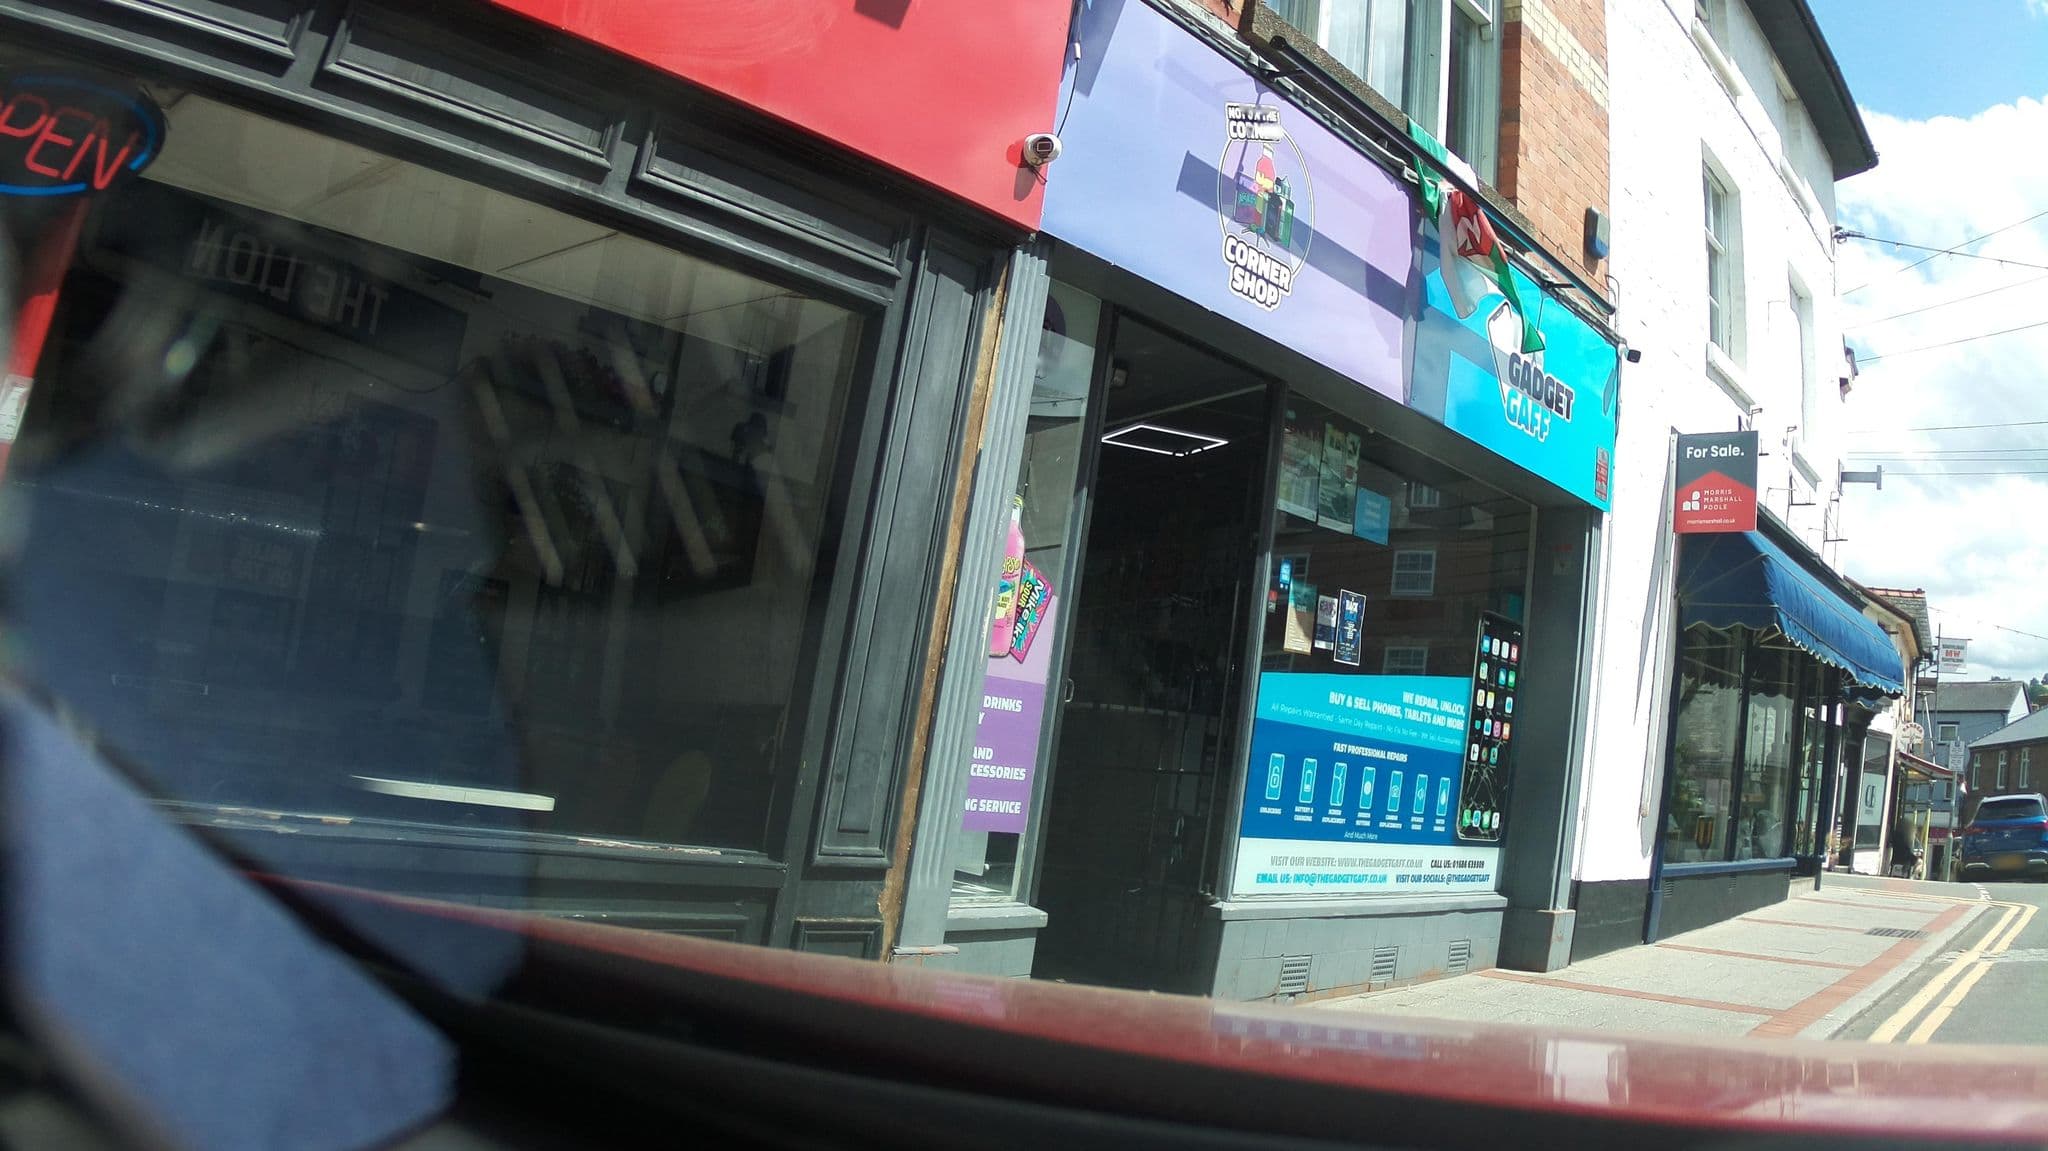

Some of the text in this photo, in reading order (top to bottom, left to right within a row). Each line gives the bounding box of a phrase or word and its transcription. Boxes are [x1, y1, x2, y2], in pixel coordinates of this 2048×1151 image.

[1228, 120, 1281, 140] CORN
[0, 94, 139, 190] PEN
[1224, 235, 1292, 292] CORNER
[1231, 265, 1280, 307] SHOP
[1508, 351, 1574, 421] GADGET
[1505, 388, 1551, 442] GAFF
[1686, 444, 1745, 459] For Sale.
[1018, 581, 1033, 608] SOUR
[1021, 580, 1045, 621] Mike
[983, 695, 1022, 712] DRINKS
[1328, 691, 1344, 706] BUY
[1347, 695, 1353, 708] &
[1354, 697, 1371, 711] SELL
[1404, 707, 1432, 724] TABLETS
[1432, 713, 1447, 727] AND
[1447, 716, 1465, 731] MORE
[1333, 742, 1408, 762] FAST PROFESSIONAL REPAIRS
[979, 799, 1022, 814] SERVICE
[1270, 855, 1289, 867] VISIT
[1289, 856, 1305, 867] OUR
[1305, 856, 1337, 867] WEBSITE:
[1430, 859, 1443, 869] CALL
[1256, 872, 1278, 884] EMAIL
[1280, 873, 1292, 884] US:
[1396, 873, 1410, 883] VISIT
[1410, 873, 1423, 884] OUR
[1423, 873, 1446, 884] SOCIALS:
